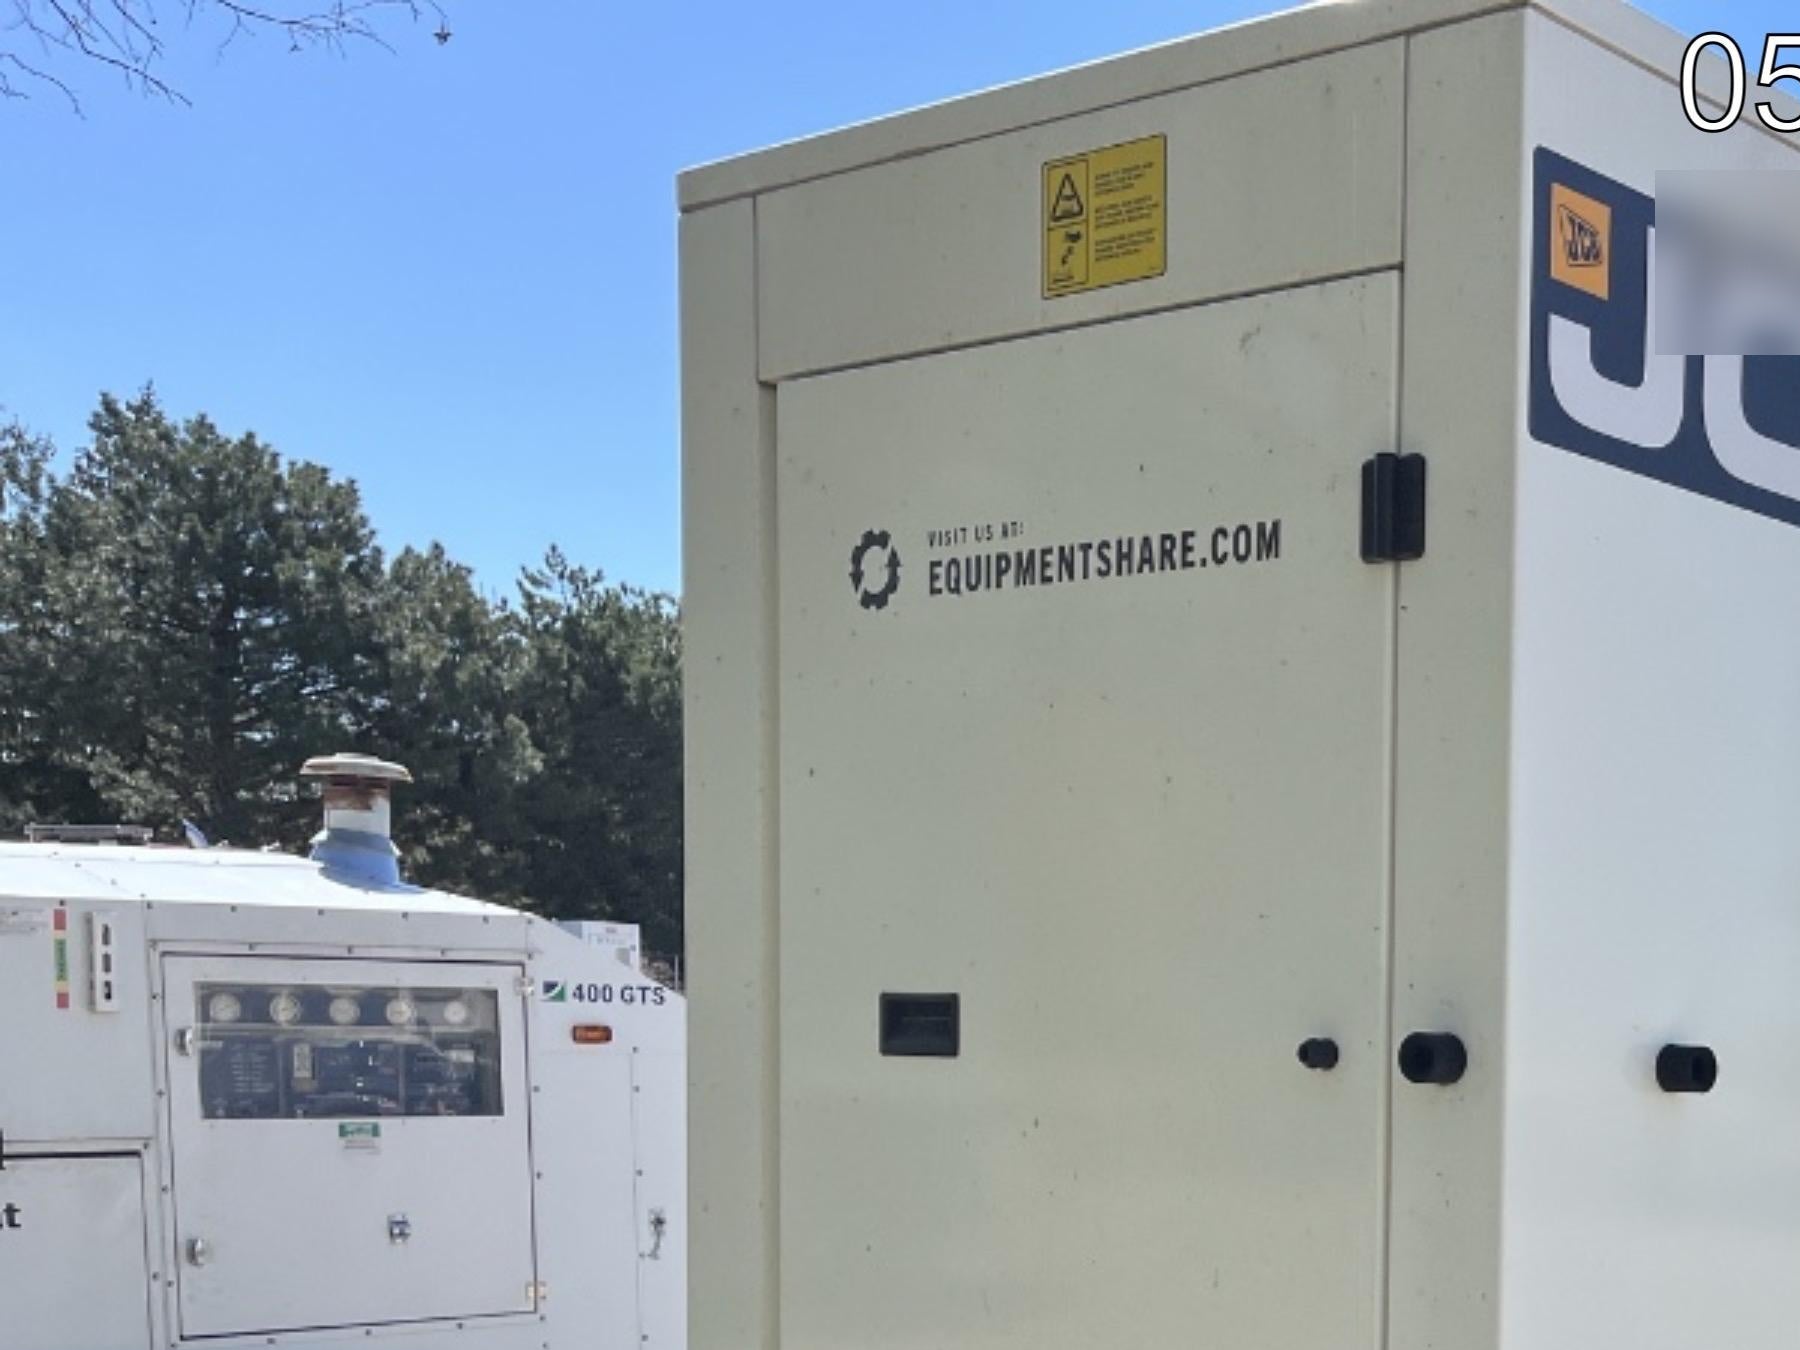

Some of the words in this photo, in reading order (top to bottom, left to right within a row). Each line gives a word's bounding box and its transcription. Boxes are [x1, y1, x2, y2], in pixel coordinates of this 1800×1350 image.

[928, 527, 968, 548] VISIT
[974, 524, 994, 543] US
[929, 519, 1282, 597] EQUIPMENTSHARE.COM
[572, 983, 614, 1003] 400
[620, 985, 667, 1006] GTS
